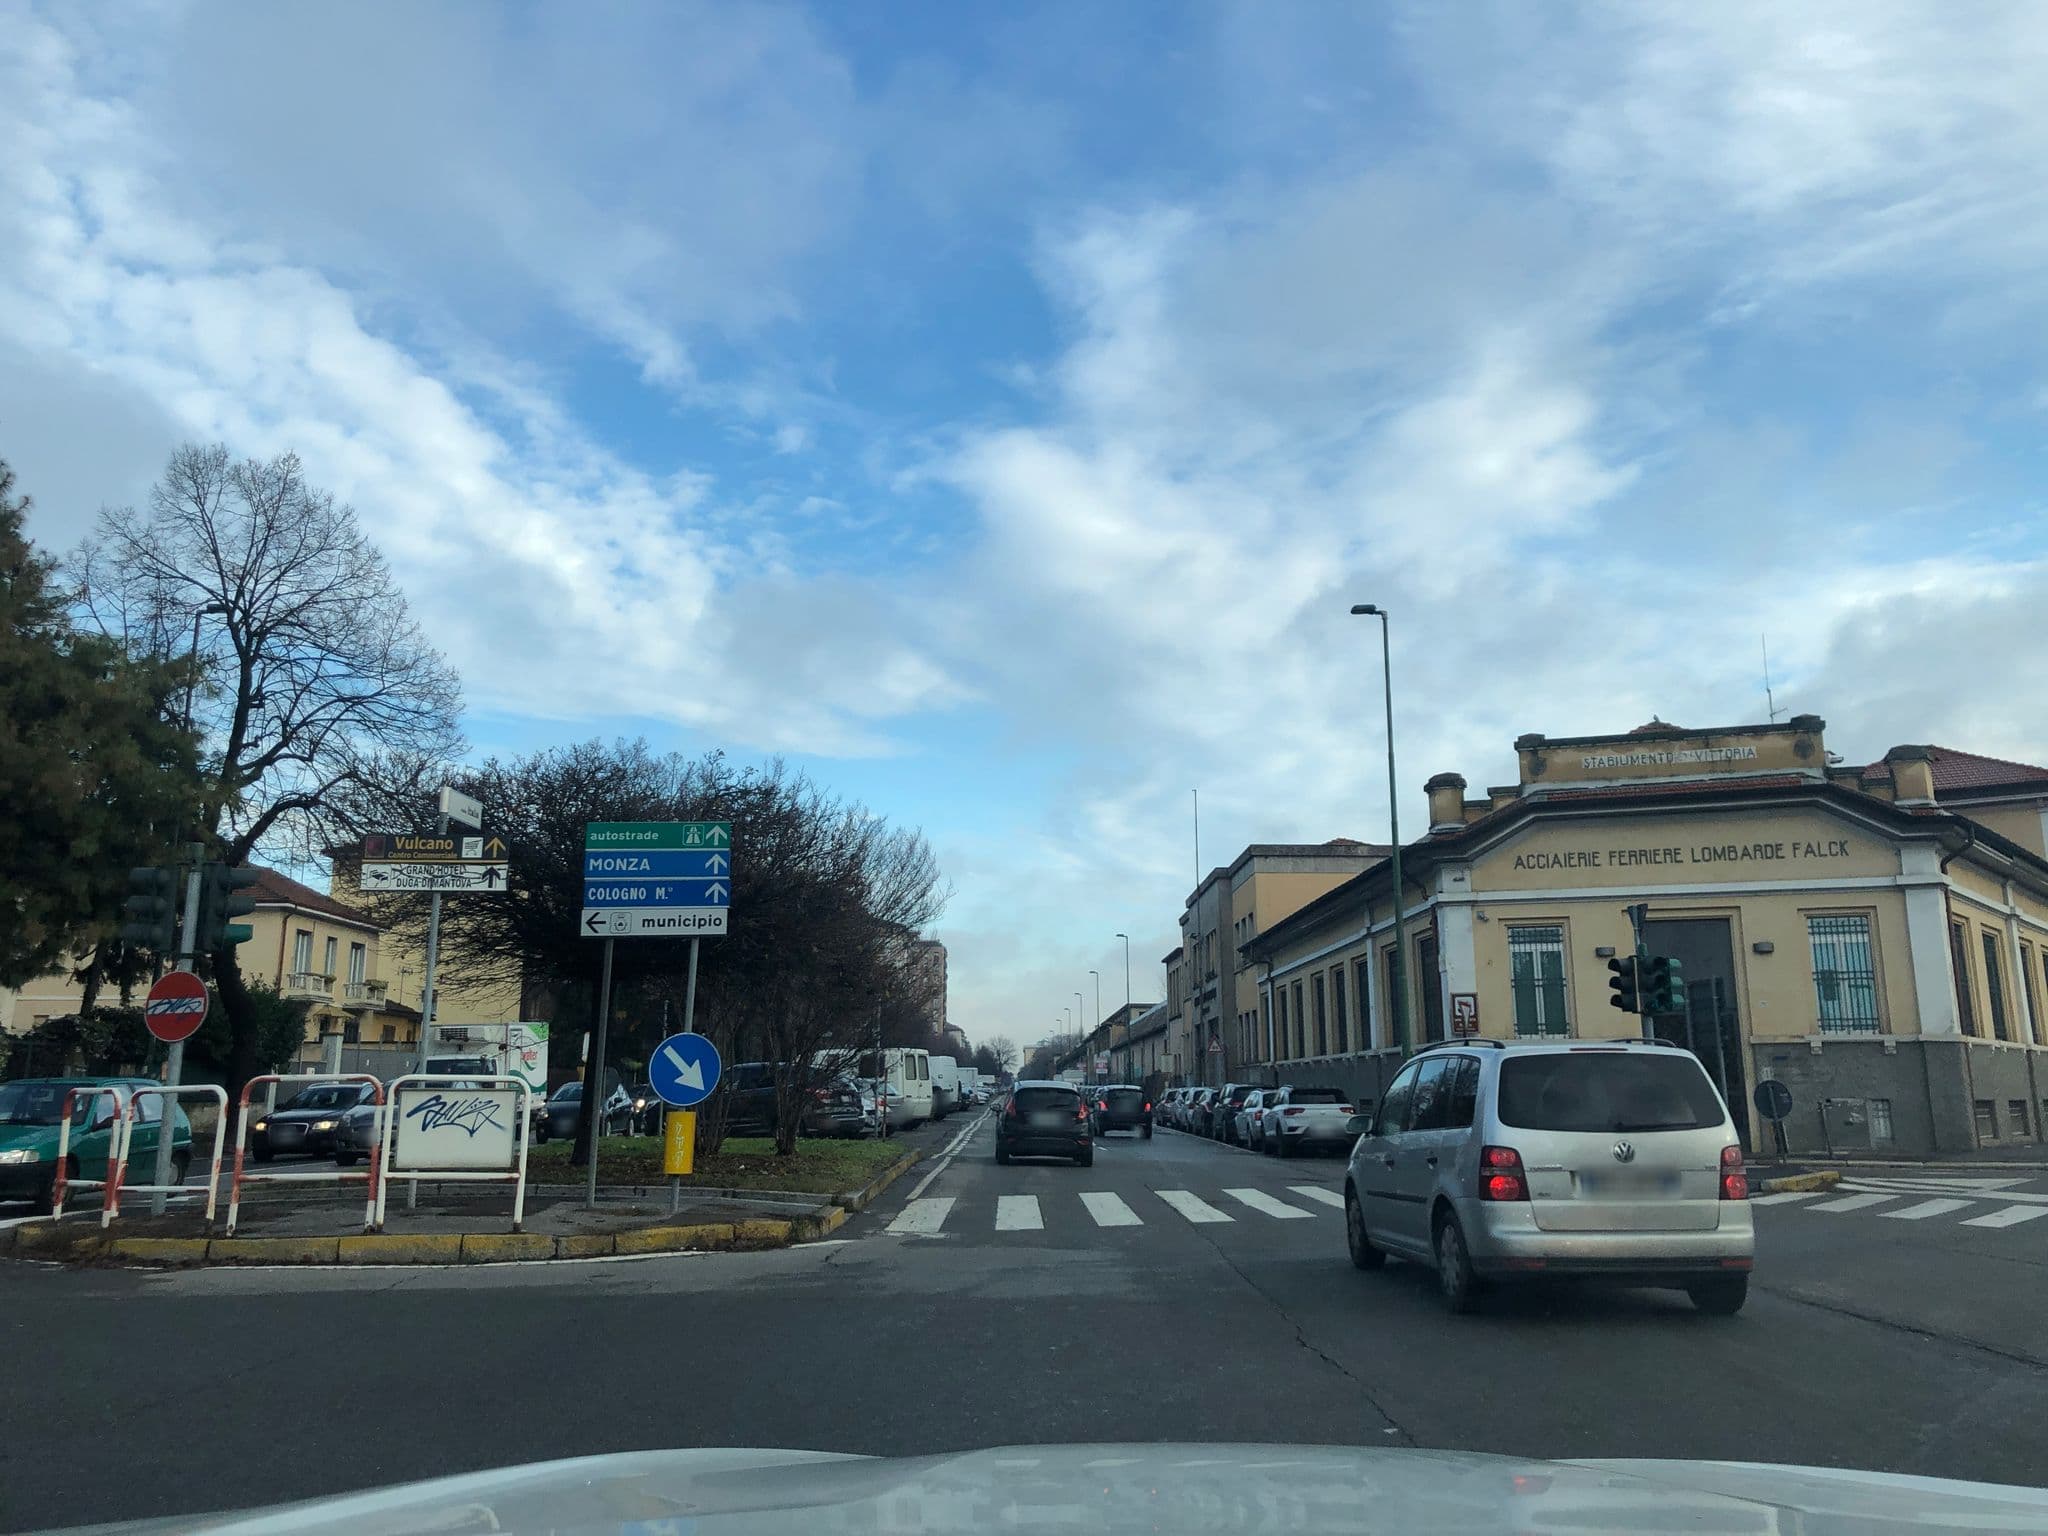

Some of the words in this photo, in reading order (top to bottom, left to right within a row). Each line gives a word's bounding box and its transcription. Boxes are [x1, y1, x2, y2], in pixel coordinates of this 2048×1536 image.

[1694, 747, 1756, 763] VITTORIA
[590, 830, 659, 841] autostrade
[395, 836, 454, 850] Vulcano
[1514, 851, 1601, 871] ACCIAIERIE
[1608, 847, 1684, 867] FERRIERE
[1691, 841, 1786, 863] LOMBARDE
[1792, 839, 1851, 859] FALCK
[406, 865, 434, 875] GRAND
[437, 864, 465, 875] HOTEL
[589, 858, 650, 871] MONZA
[431, 878, 472, 888] MANTOVA
[588, 887, 647, 900] COLOGNO
[642, 914, 722, 929] municipio
